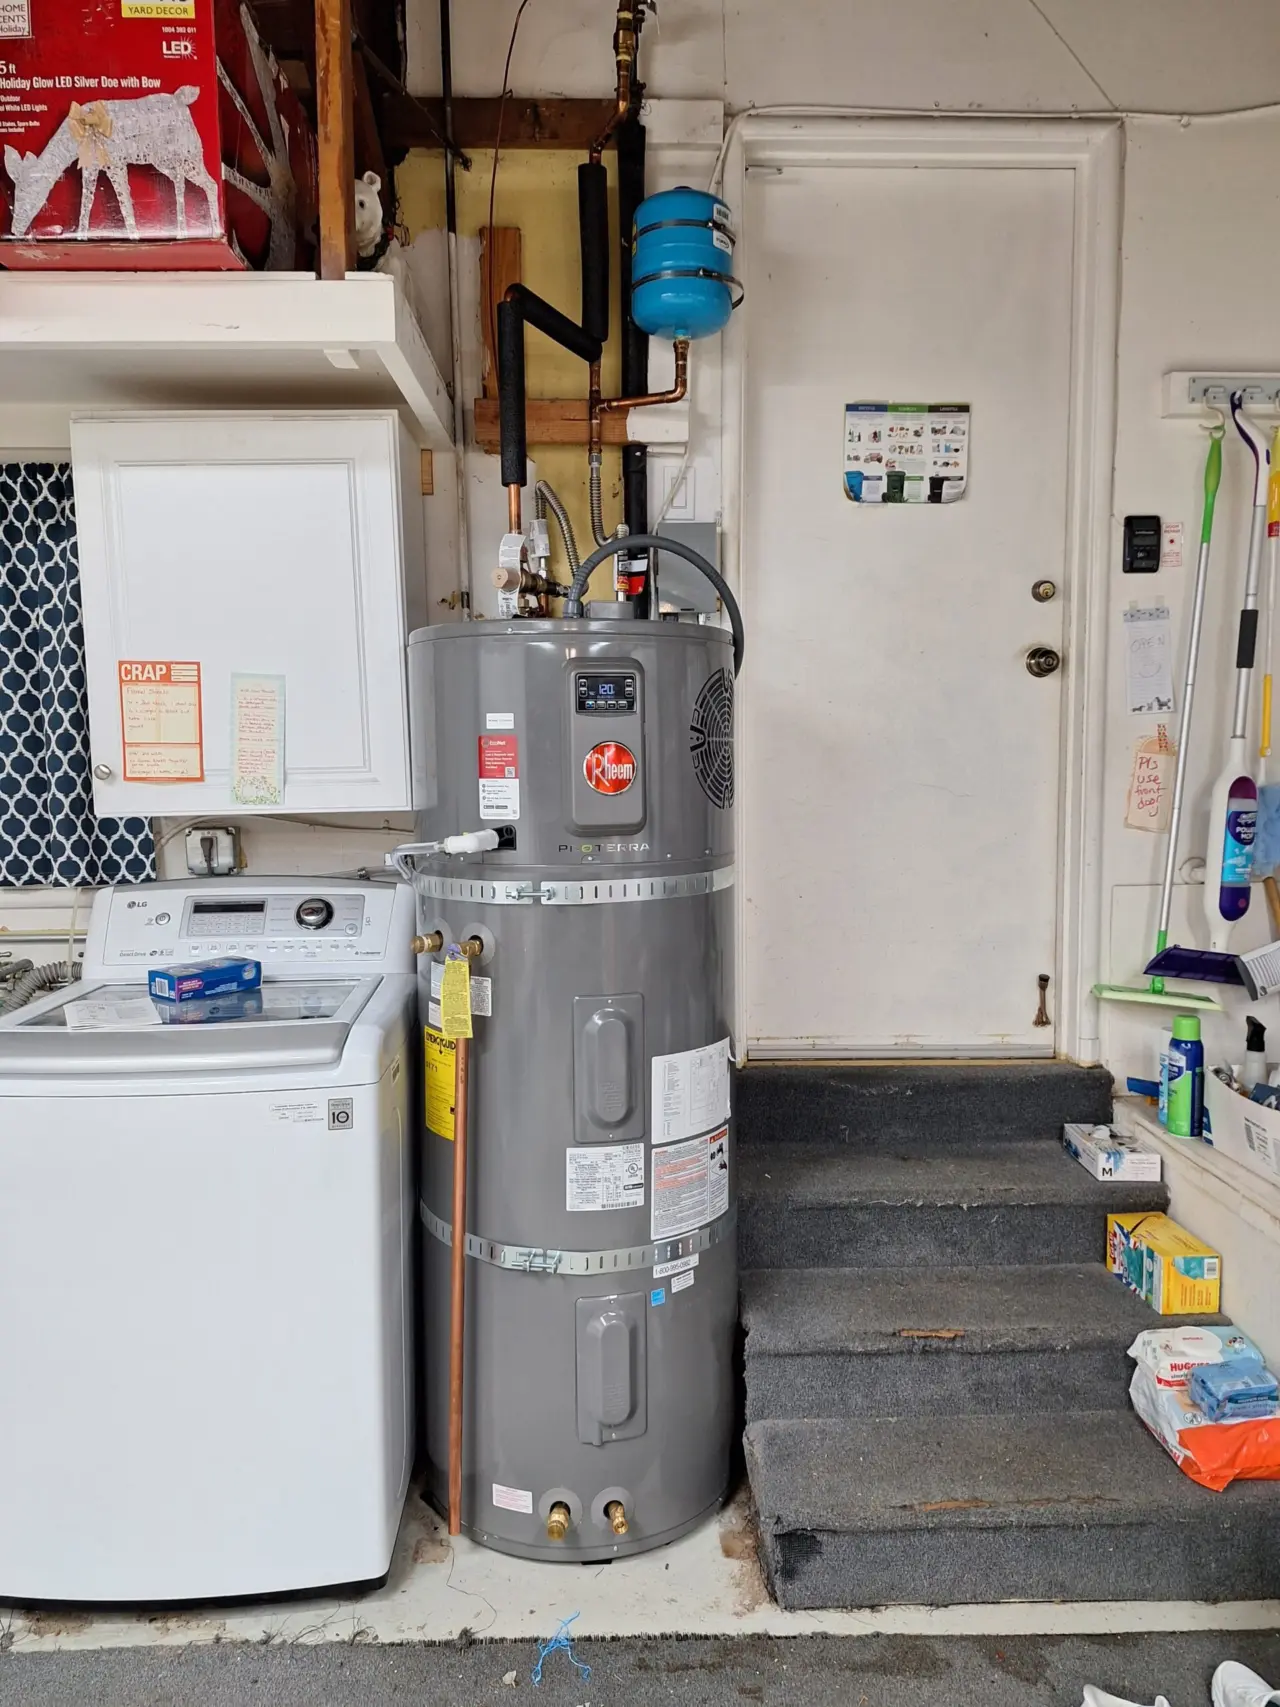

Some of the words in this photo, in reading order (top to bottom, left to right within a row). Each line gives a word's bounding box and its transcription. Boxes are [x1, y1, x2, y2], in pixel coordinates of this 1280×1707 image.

[156, 7, 188, 15] DECOR
[162, 40, 192, 54] LED
[9, 63, 16, 74] ft
[0, 77, 31, 90] Holiday
[33, 76, 53, 88] Glow
[56, 76, 72, 88] LED
[74, 76, 99, 88] Silver
[101, 76, 118, 88] Doe
[120, 76, 139, 88] with
[142, 76, 161, 88] Bow
[21, 104, 31, 112] LED
[121, 663, 167, 681] CRAP
[599, 683, 613, 694] 120
[585, 748, 633, 787] Rheem
[1138, 756, 1158, 770] Pls
[1137, 774, 1162, 785] use
[1135, 785, 1167, 796] front
[1137, 794, 1164, 810] door
[332, 1110, 350, 1124] 10
[1102, 1167, 1113, 1177] M
[1170, 1362, 1210, 1372] HUGG
